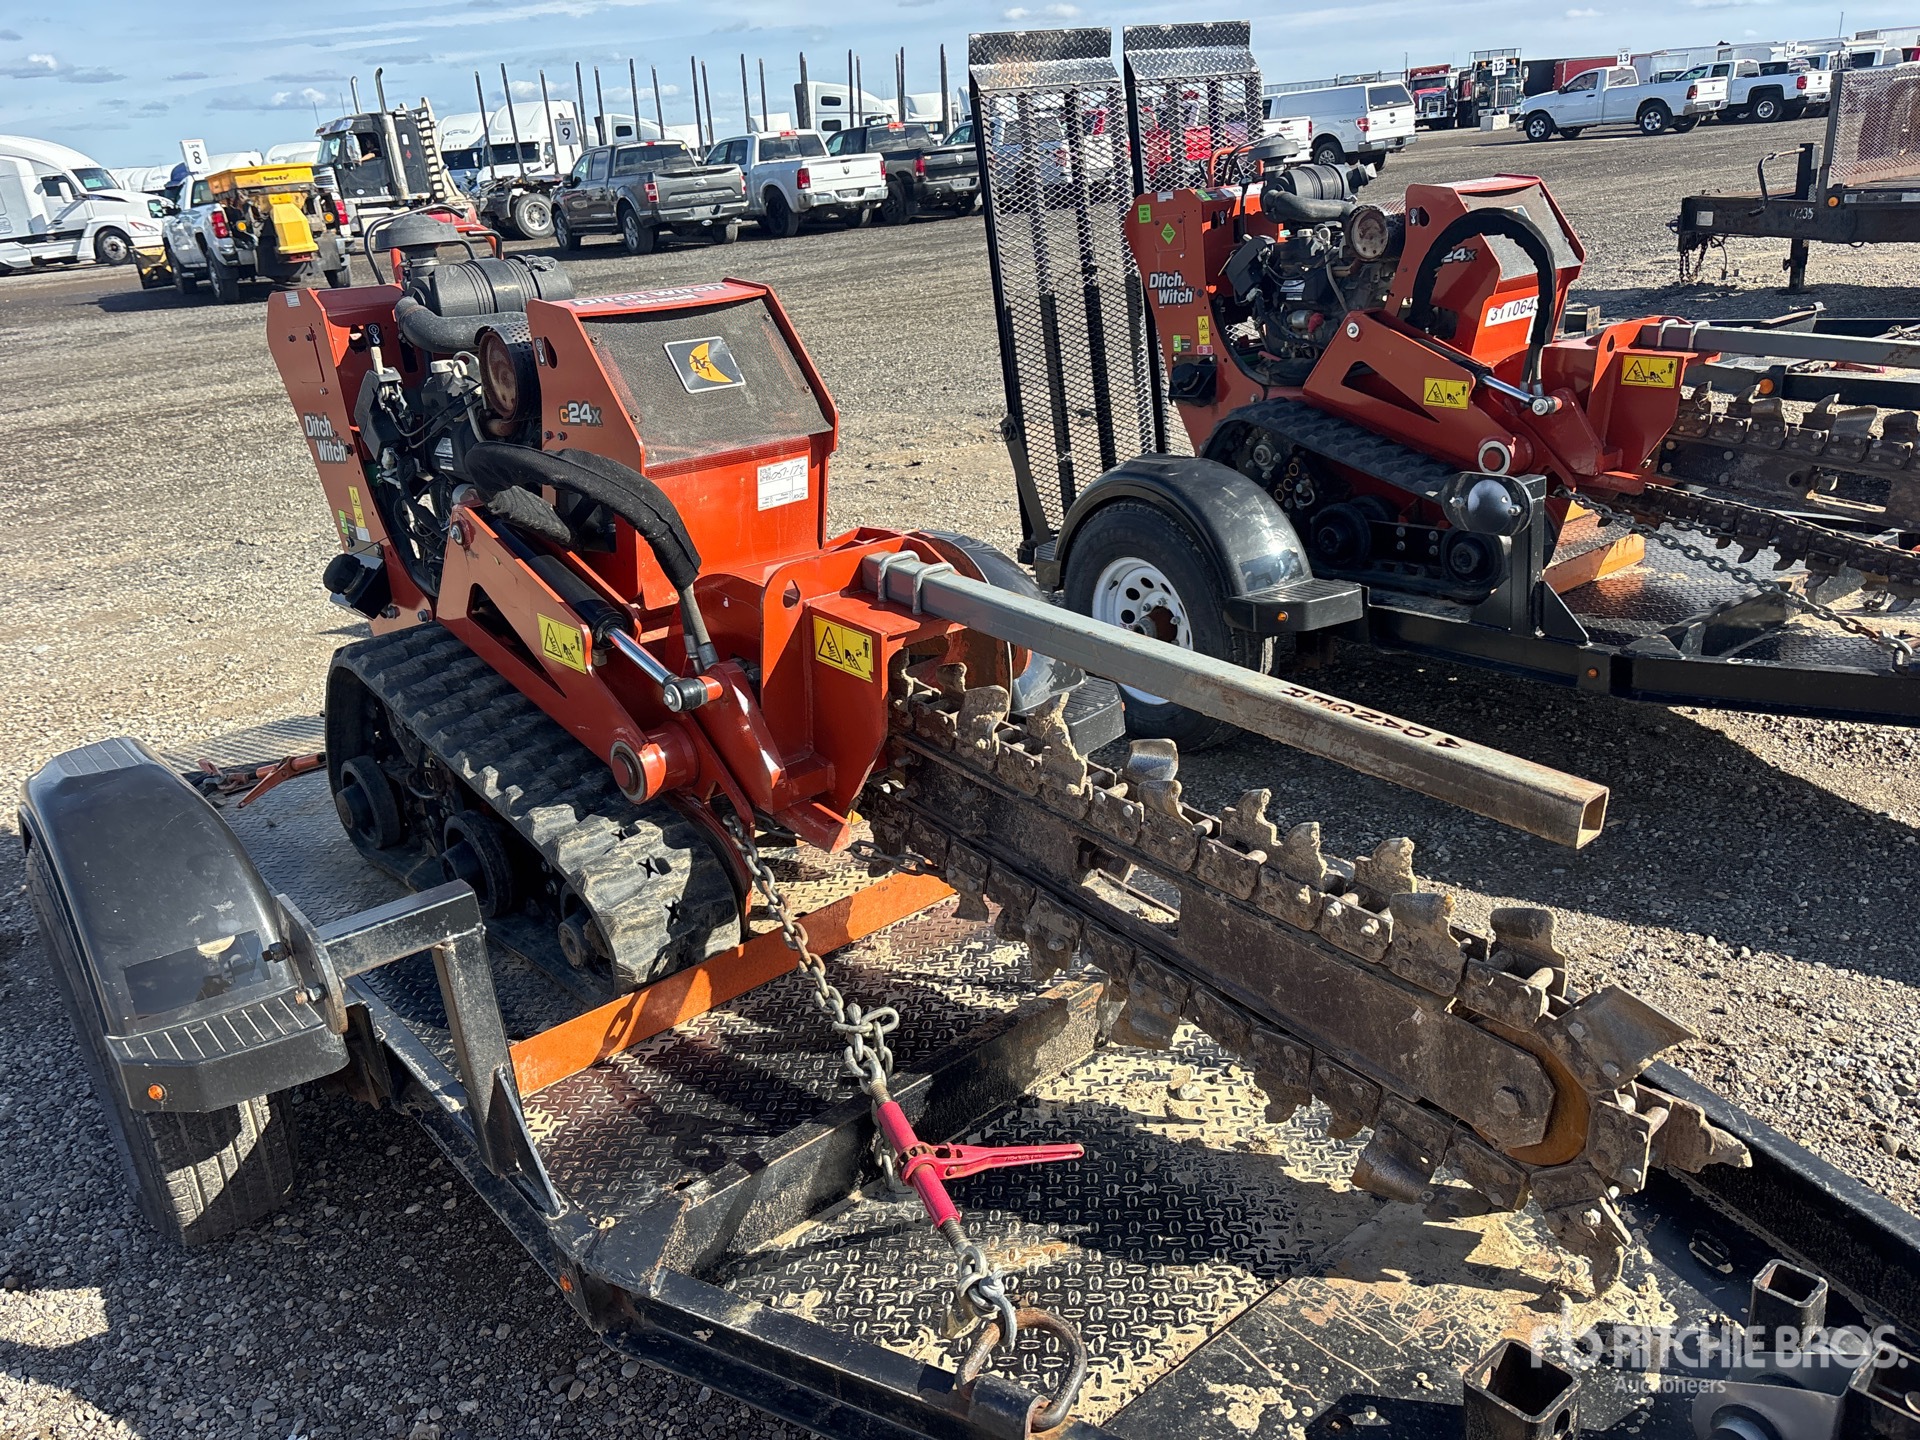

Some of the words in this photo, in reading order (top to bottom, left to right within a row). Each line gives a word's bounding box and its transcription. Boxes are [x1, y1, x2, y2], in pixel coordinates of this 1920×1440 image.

[1618, 53, 1629, 62] 13
[1493, 62, 1505, 72] 12
[562, 127, 571, 140] 9
[192, 150, 202, 165] 8
[1149, 271, 1183, 289] Ditch
[1158, 288, 1193, 304] Witch
[304, 414, 333, 437] Ditch
[316, 439, 347, 462] Witch
[1280, 686, 1433, 739] DANGER
